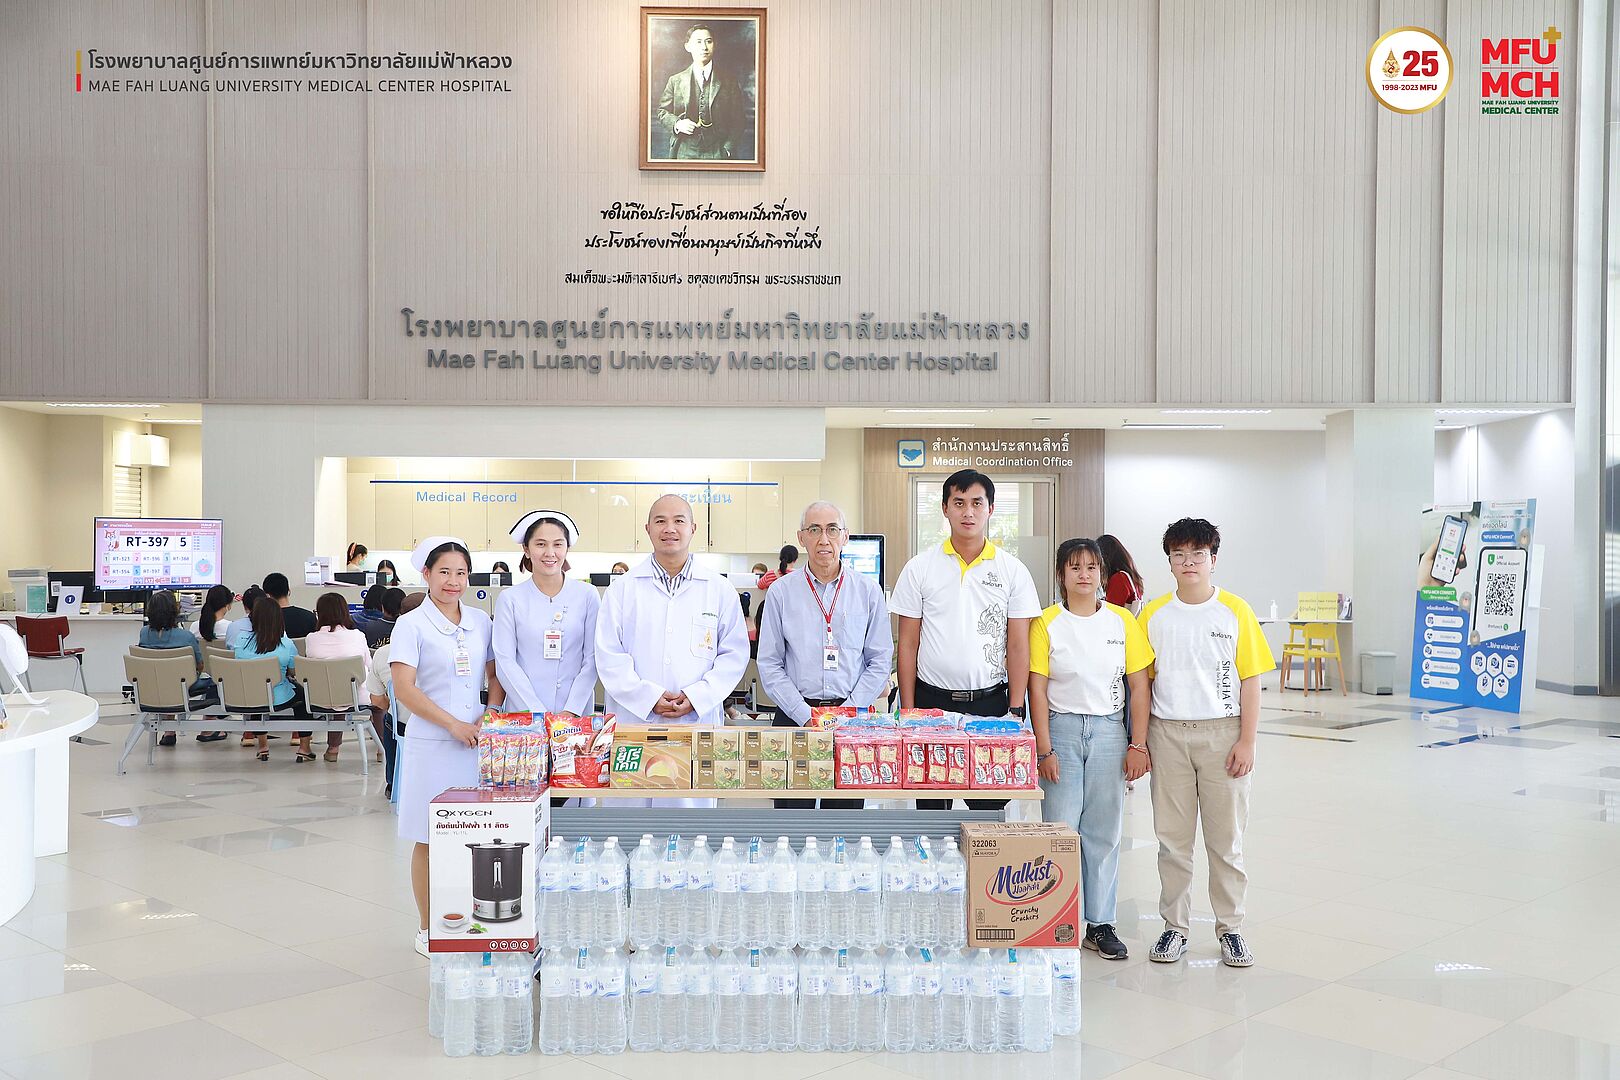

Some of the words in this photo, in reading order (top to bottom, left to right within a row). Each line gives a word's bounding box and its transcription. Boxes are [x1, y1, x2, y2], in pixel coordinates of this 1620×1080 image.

[765, 273, 841, 285] พระบรมราชชนก
[400, 307, 1030, 348] โรงพยาบาลศูนย์การแพทย์มหาวิทยาลัยแม่ฟ้าหลวง
[427, 350, 476, 370] Mae
[483, 350, 524, 370] Fah
[532, 350, 602, 375] Luang
[609, 350, 721, 375] University
[728, 350, 816, 371] Medical
[824, 350, 898, 371] Center
[906, 350, 998, 375] Hospital
[932, 433, 1070, 452] สำนักงานประสานสิทธิ์
[932, 456, 972, 467] Medical
[975, 456, 1039, 467] Coordination
[1042, 456, 1073, 467] Office
[416, 491, 466, 503] Medical
[472, 491, 517, 503] Record
[126, 536, 169, 547] RT-397
[180, 537, 187, 547] 5
[1222, 660, 1231, 700] SINGHA
[553, 726, 582, 738] โอวัลติน
[972, 840, 997, 848] 322063
[991, 860, 1053, 898] Malkist
[1011, 907, 1039, 916] Crunchy
[1011, 914, 1039, 923] Crackers
